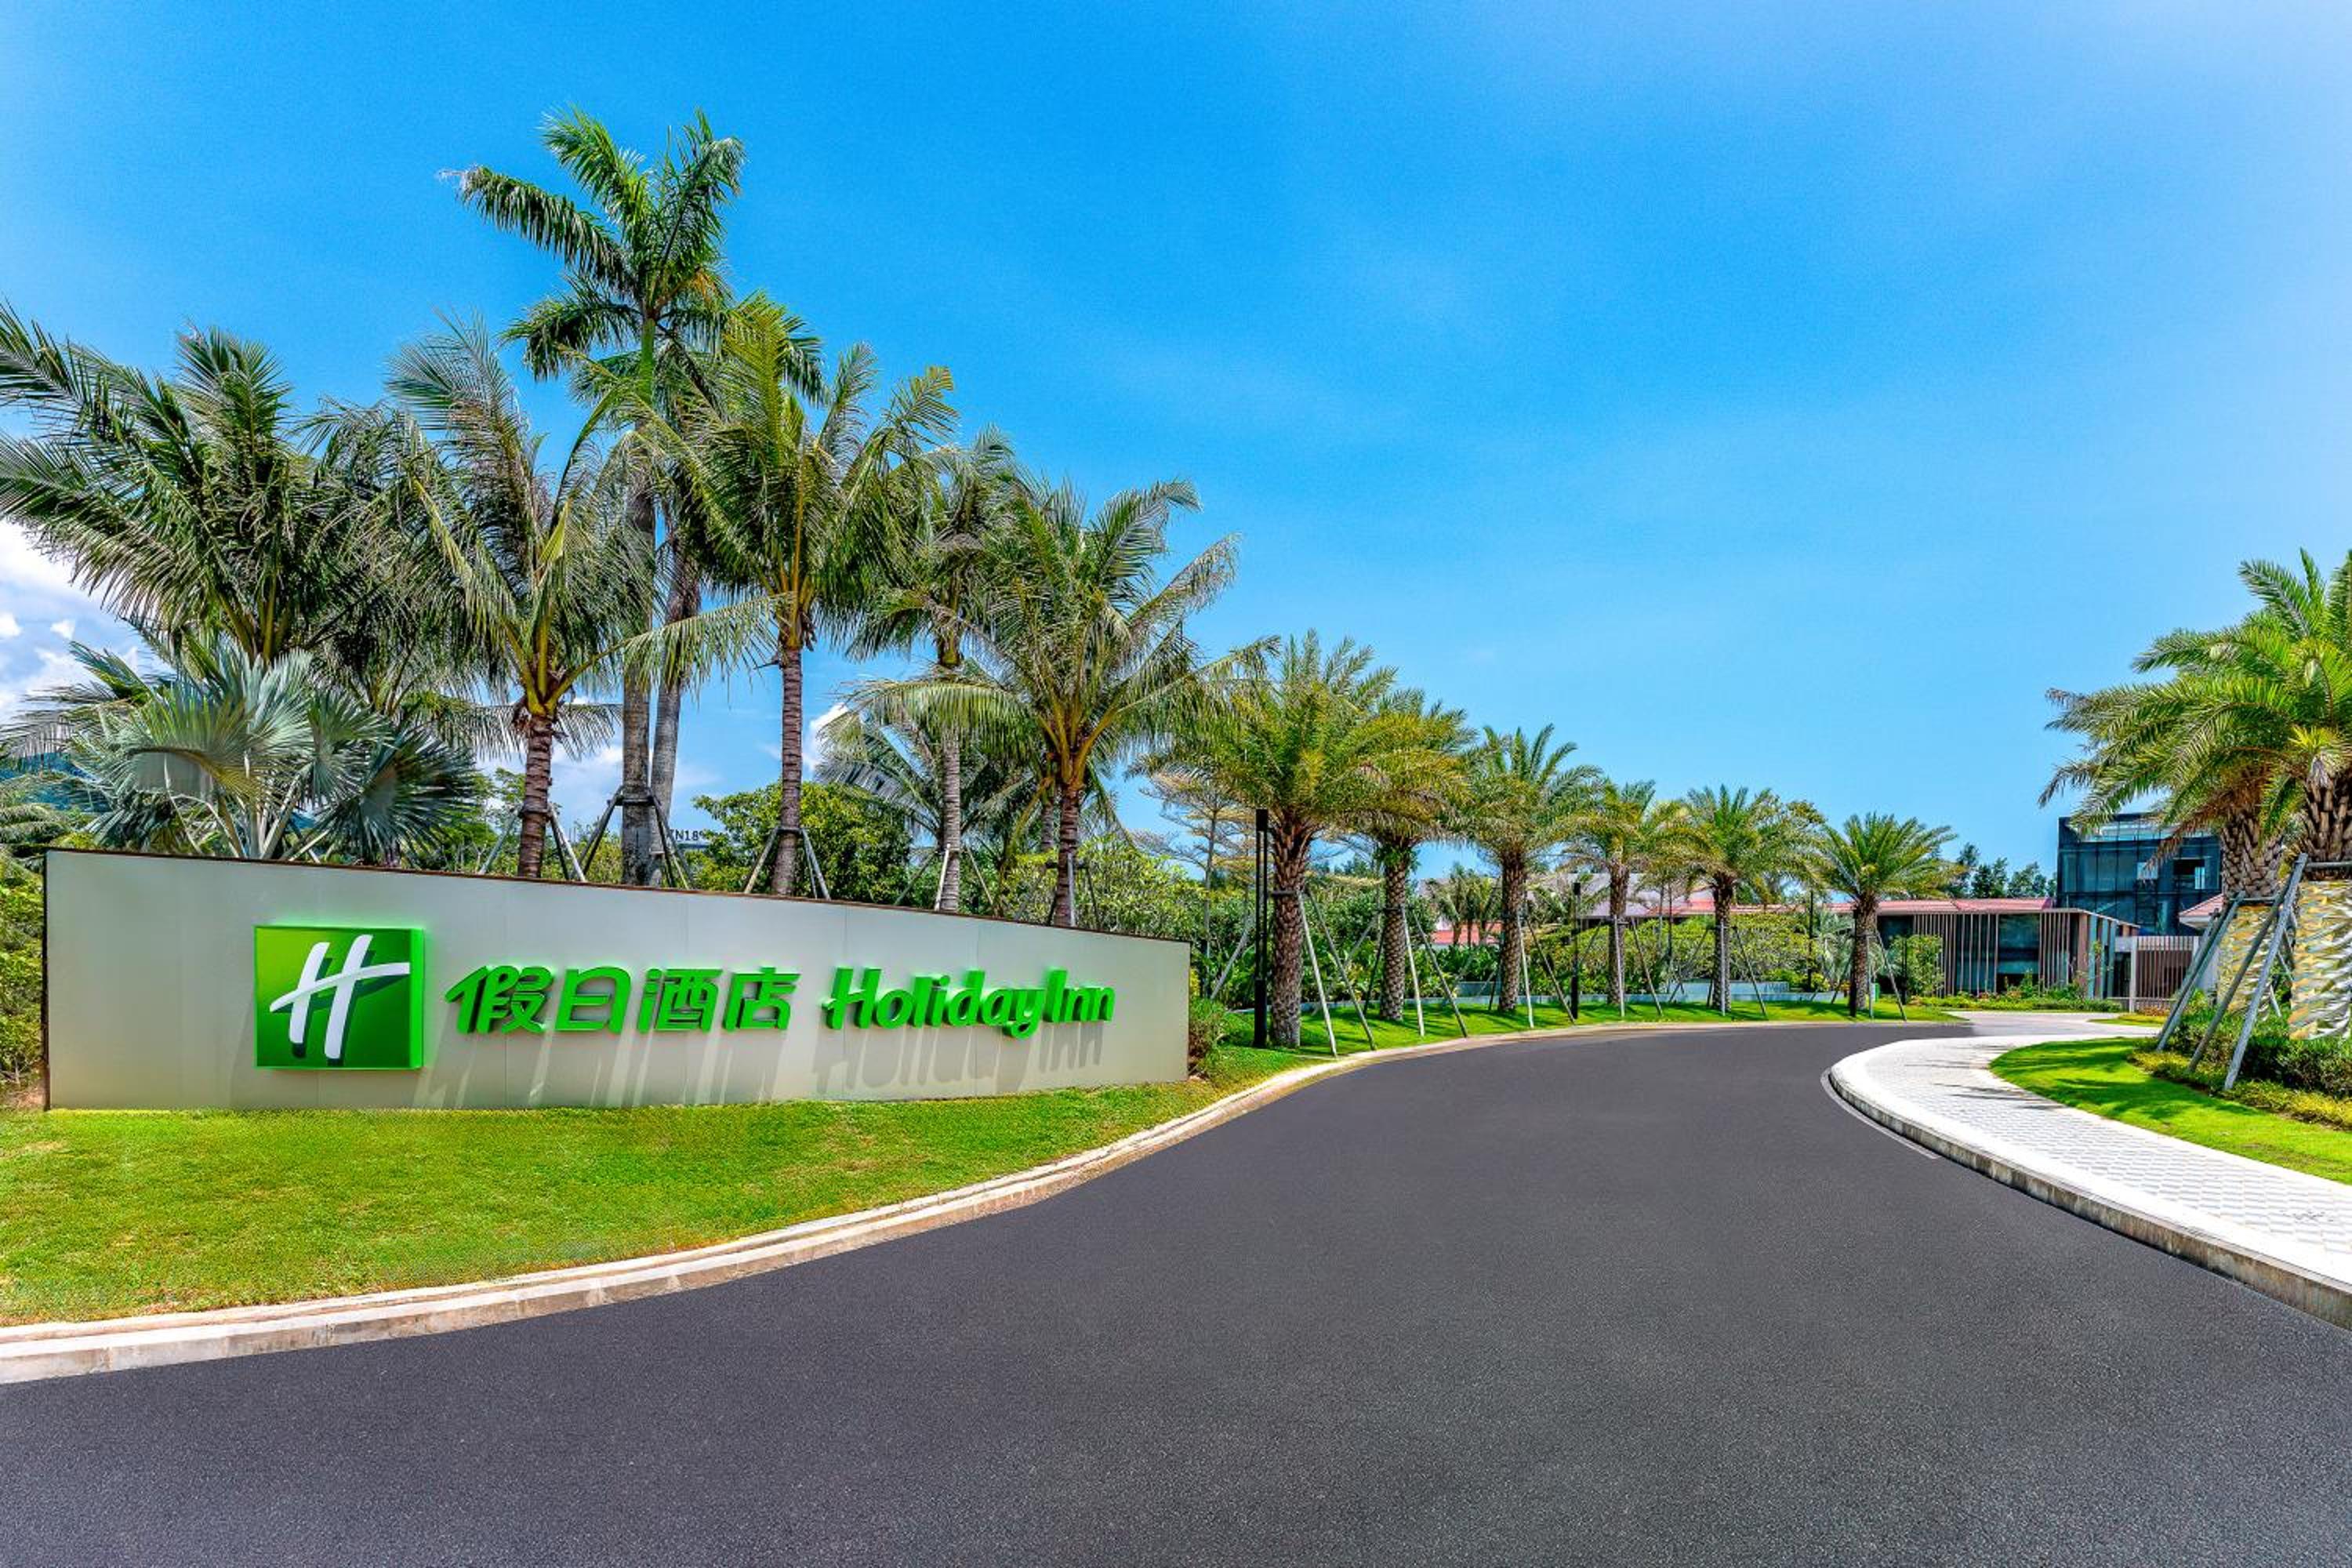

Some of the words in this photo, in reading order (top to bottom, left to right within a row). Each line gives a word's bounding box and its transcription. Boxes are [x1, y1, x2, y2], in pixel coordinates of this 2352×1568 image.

[269, 934, 409, 1059] H
[445, 966, 800, 1033] 假日酒店
